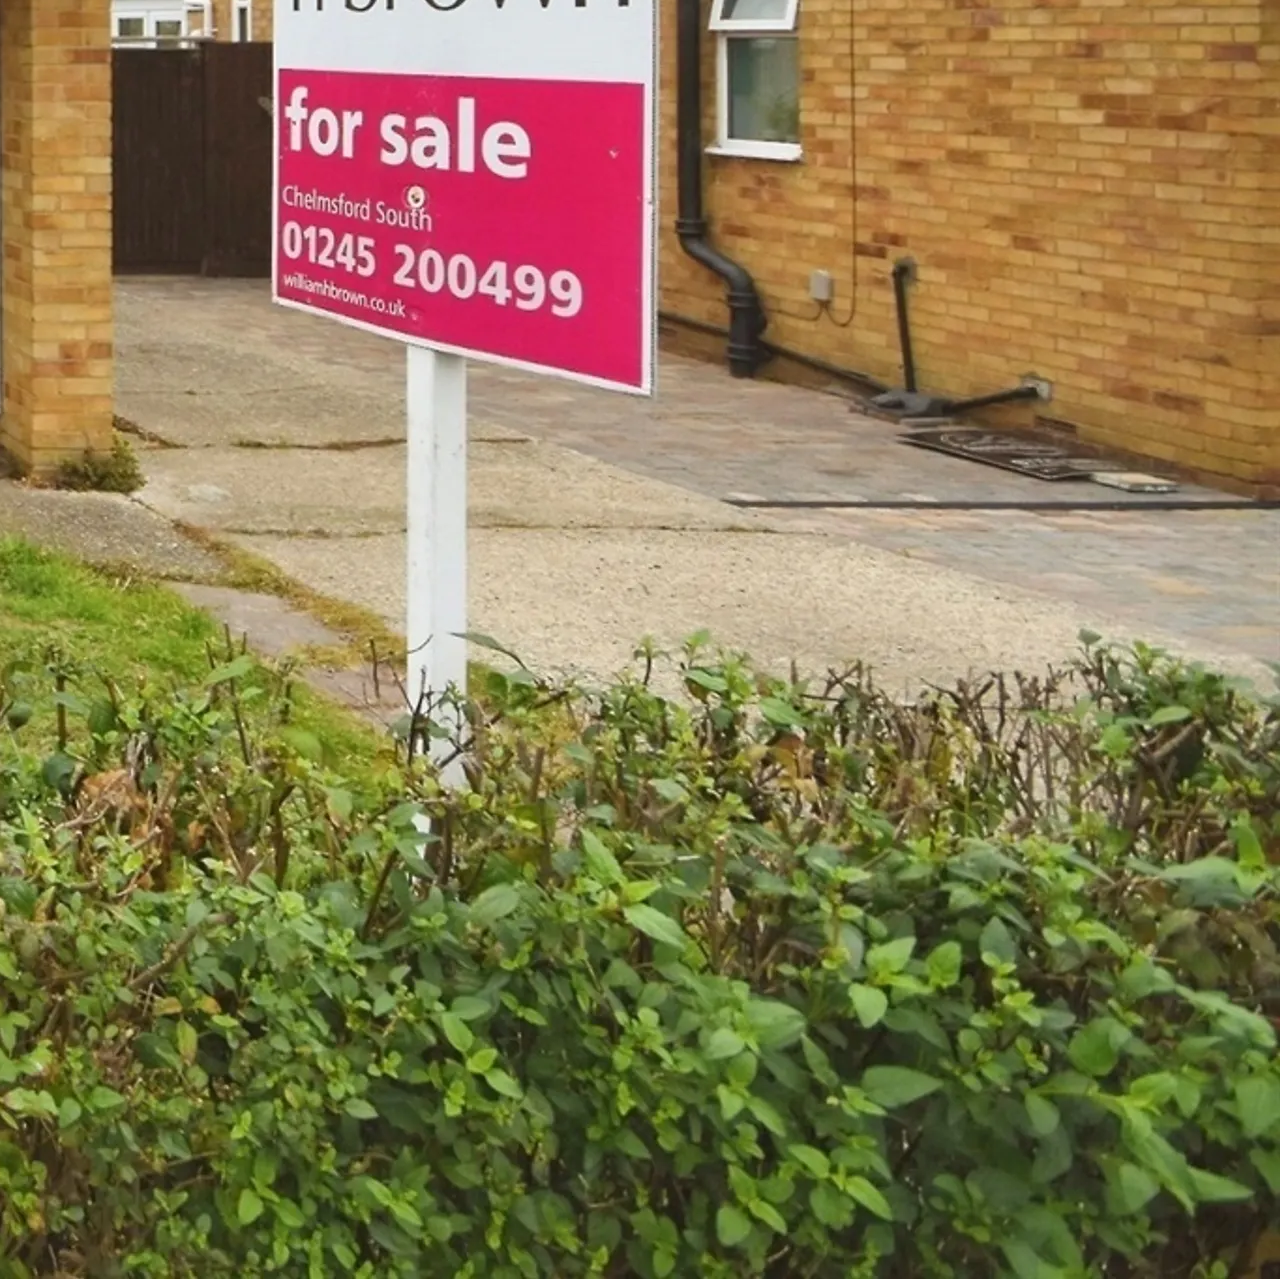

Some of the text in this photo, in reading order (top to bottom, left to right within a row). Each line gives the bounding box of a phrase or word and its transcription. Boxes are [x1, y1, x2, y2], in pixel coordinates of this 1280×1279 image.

[285, 86, 532, 179] for sale
[281, 185, 433, 232] Chelmsford South
[282, 220, 583, 318] 01245 200499
[283, 272, 406, 317] williamhbrown.co.uk
